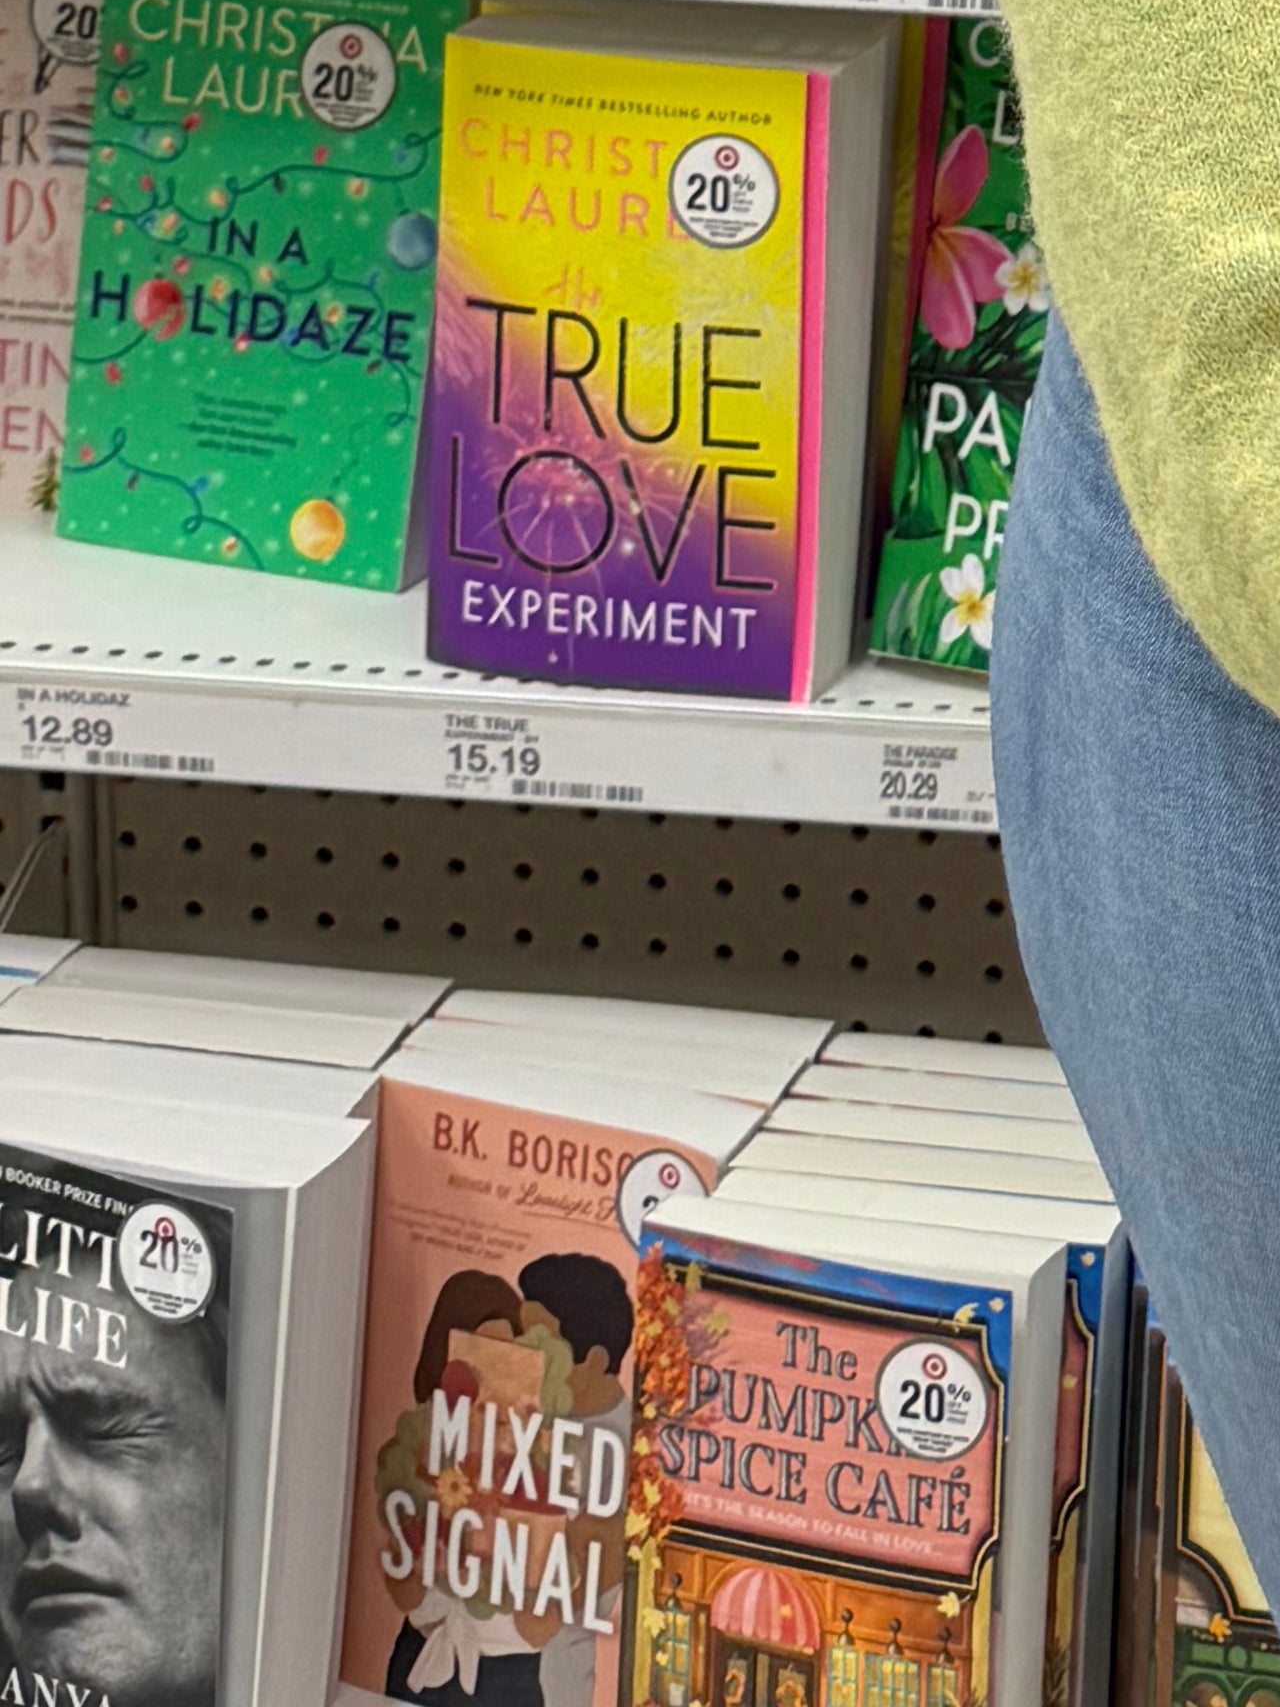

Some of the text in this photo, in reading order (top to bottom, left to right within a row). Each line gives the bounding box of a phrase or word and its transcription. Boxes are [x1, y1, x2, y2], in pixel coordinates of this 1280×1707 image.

[510, 90, 772, 125] YORK TIMES BESTSELLING AUTHOR
[687, 174, 755, 213] 20%
[206, 218, 309, 264] IN A
[466, 298, 762, 450] TRUE
[448, 436, 776, 592] LOVE
[462, 580, 756, 652] EXPERIMENT
[39, 690, 130, 706] A HOLIDAZ
[22, 716, 112, 746] 12.89
[447, 715, 528, 732] THE TRUE
[448, 744, 540, 776] 15.19
[881, 771, 938, 800] 20.29
[433, 1112, 488, 1160] B.K.
[6, 1167, 100, 1209] BOOKER PRIZE
[776, 1320, 858, 1381] The
[900, 1380, 971, 1422] 20%
[429, 1389, 626, 1519] MIXED
[657, 1421, 972, 1536] SPICE CAFÉ
[748, 1504, 891, 1548] SEASON TO FALL IN
[381, 1489, 614, 1635] SIGNAL
